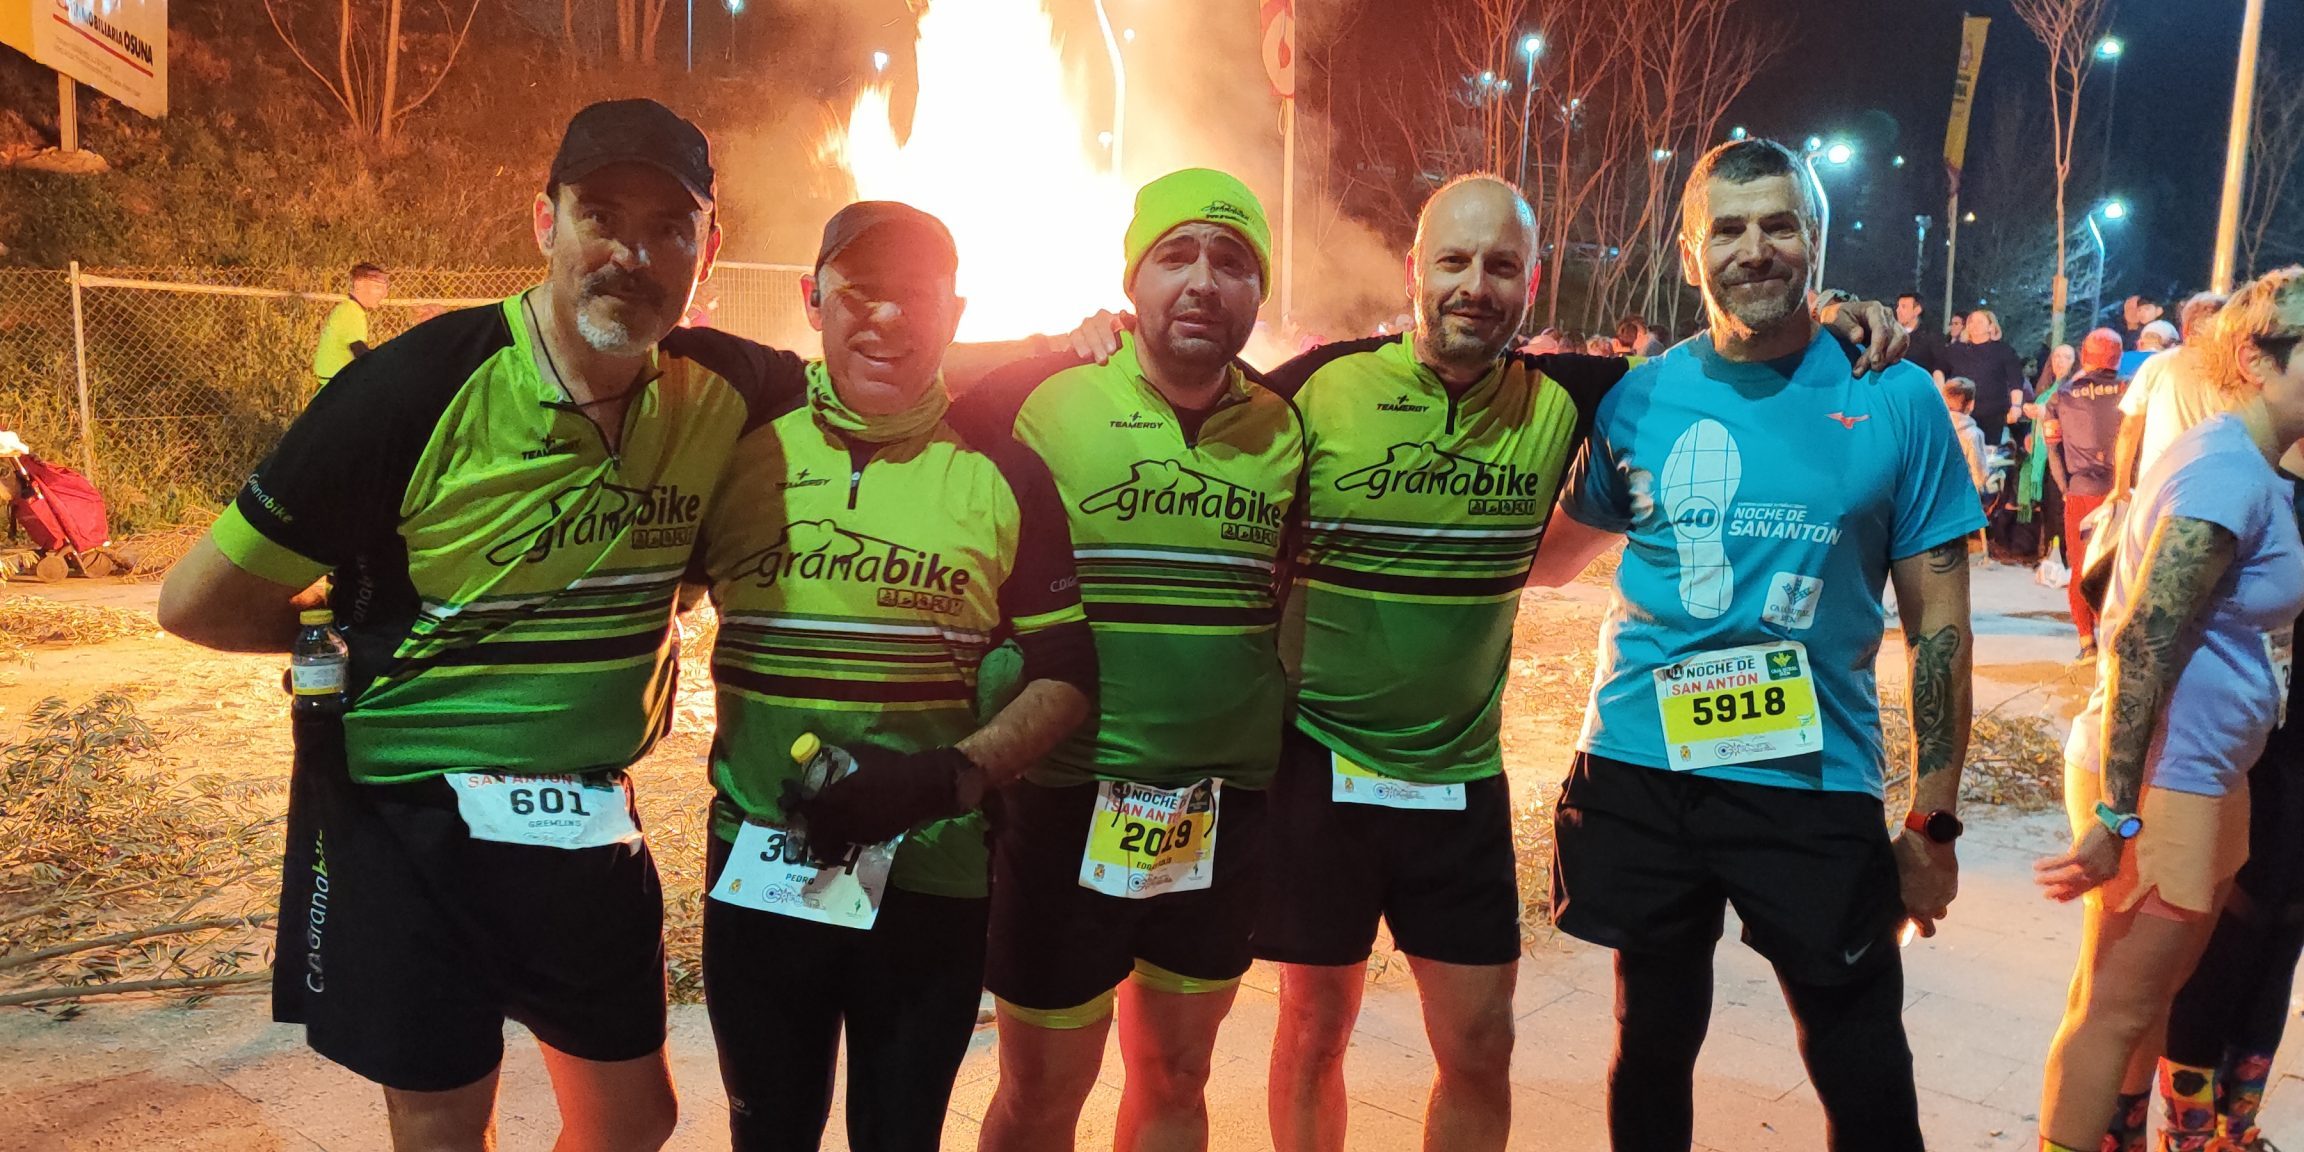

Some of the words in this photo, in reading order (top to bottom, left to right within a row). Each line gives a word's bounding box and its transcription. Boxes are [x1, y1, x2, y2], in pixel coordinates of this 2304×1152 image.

[124, 30, 153, 67] OSUNA
[1677, 508, 1716, 528] 40
[1734, 507, 1784, 521] NOCHE
[1785, 509, 1807, 522] DE
[1728, 520, 1772, 538] SAN
[1770, 521, 1842, 545] ANTÓN
[1686, 661, 1734, 678] NOCHE
[1737, 658, 1755, 672] DE
[1672, 681, 1702, 696] SAN
[1706, 672, 1758, 691] ANTÓN
[1693, 687, 1786, 726] 5918
[468, 774, 506, 789] SAN
[510, 787, 591, 816] 601
[1111, 799, 1143, 817] SAN
[1131, 789, 1178, 810] NOCHE
[1120, 819, 1193, 857] 2019
[785, 872, 815, 886] PEDRO
